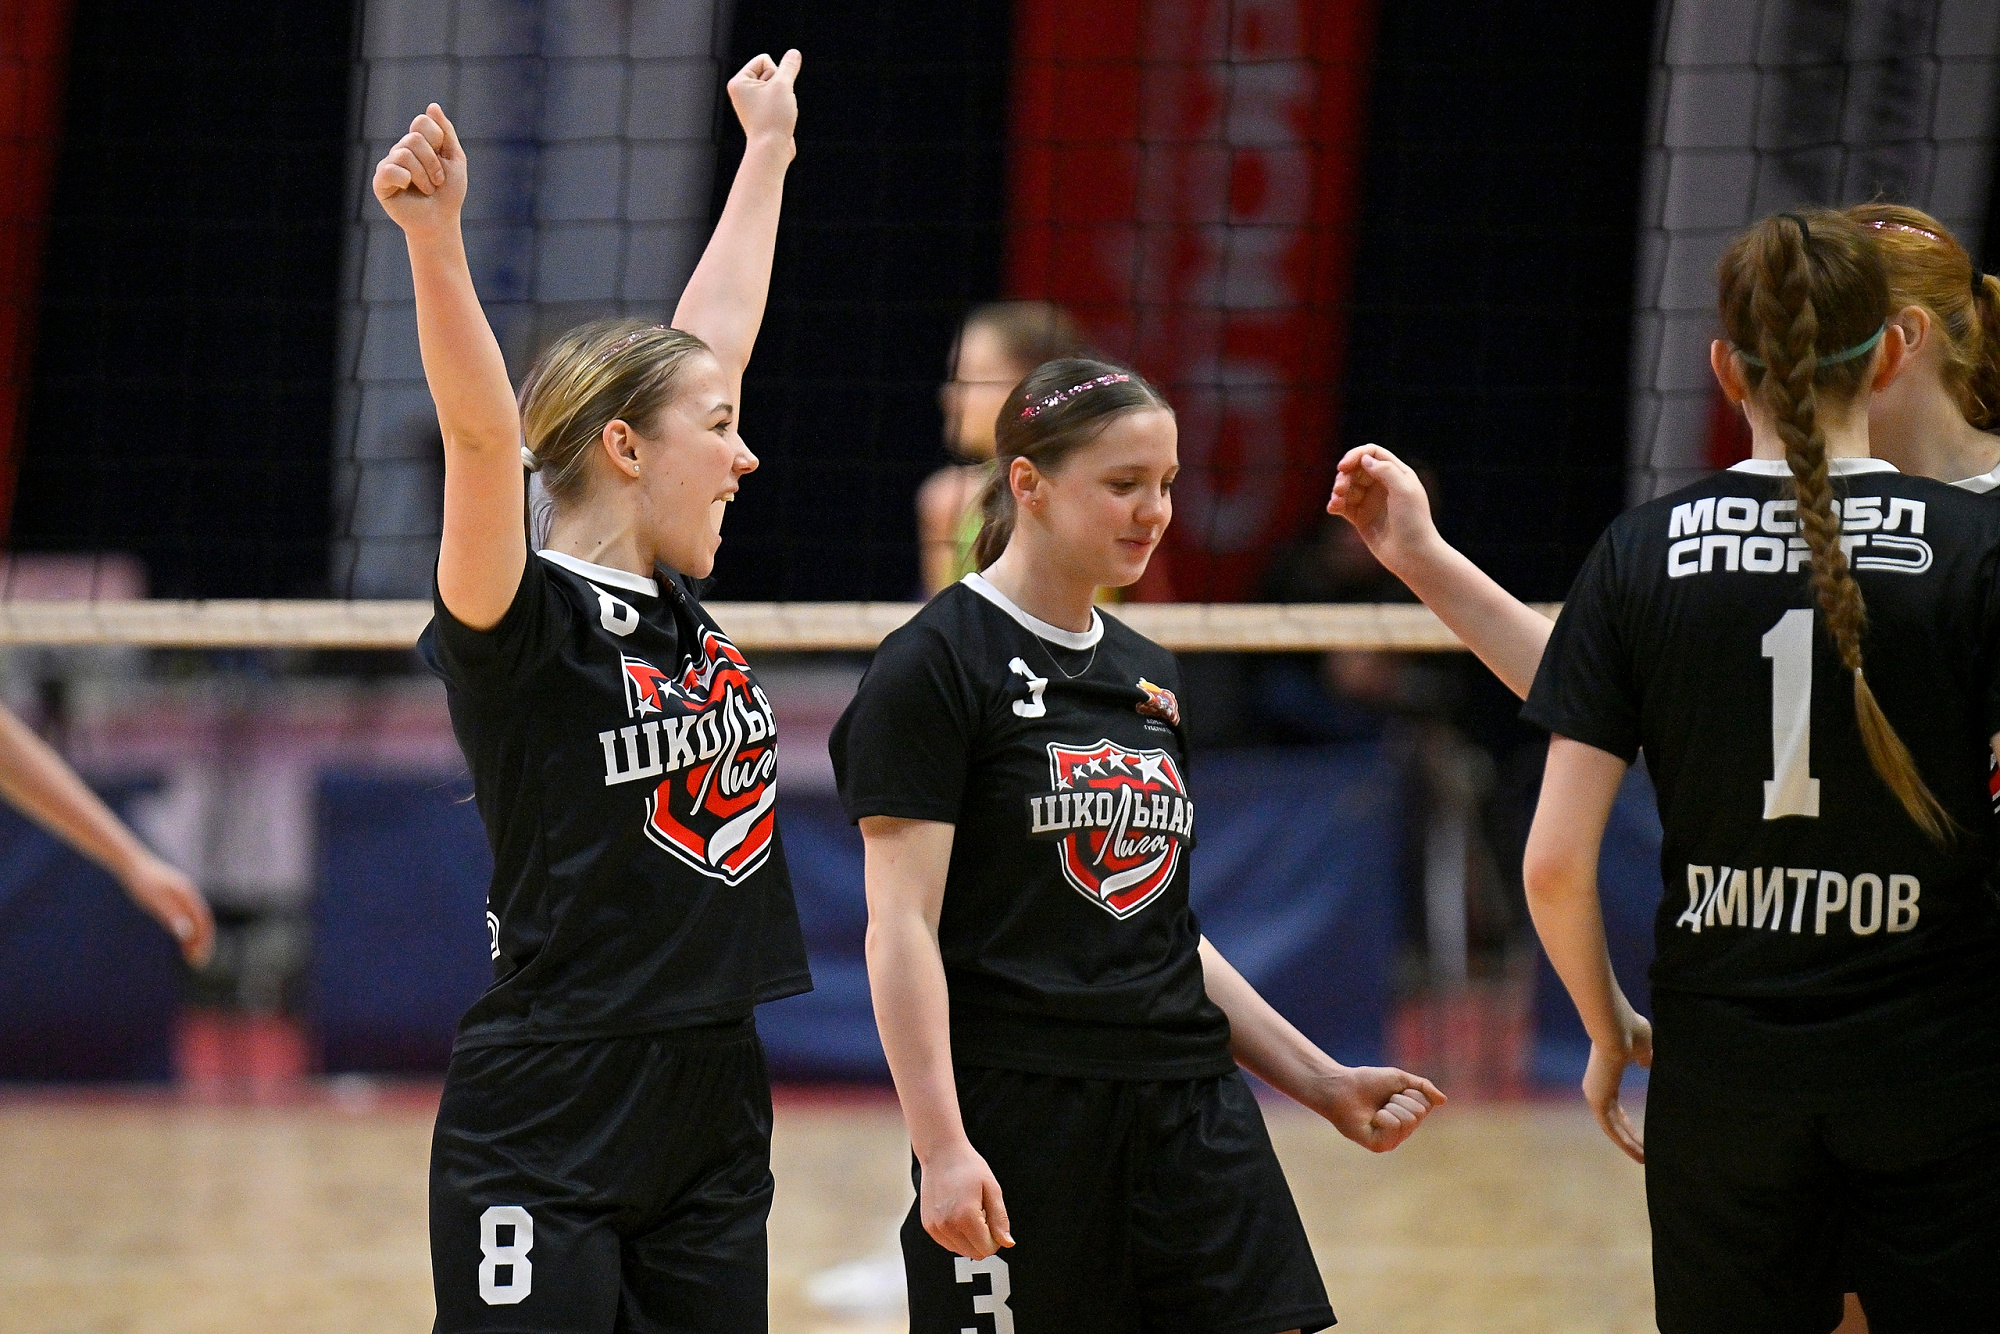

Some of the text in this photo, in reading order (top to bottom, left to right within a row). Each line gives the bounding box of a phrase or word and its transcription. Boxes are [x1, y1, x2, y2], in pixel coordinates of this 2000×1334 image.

[1668, 496, 1926, 538] МОСБЛ
[1008, 656, 1049, 718] 3
[1761, 608, 1820, 820] 1
[1030, 783, 1194, 839] ШКОЛЬНАЯ
[1092, 783, 1169, 866] Лига
[1676, 863, 1921, 935] ДМИТРОВ
[478, 1205, 534, 1306] 8
[953, 1254, 1015, 1334] 3
